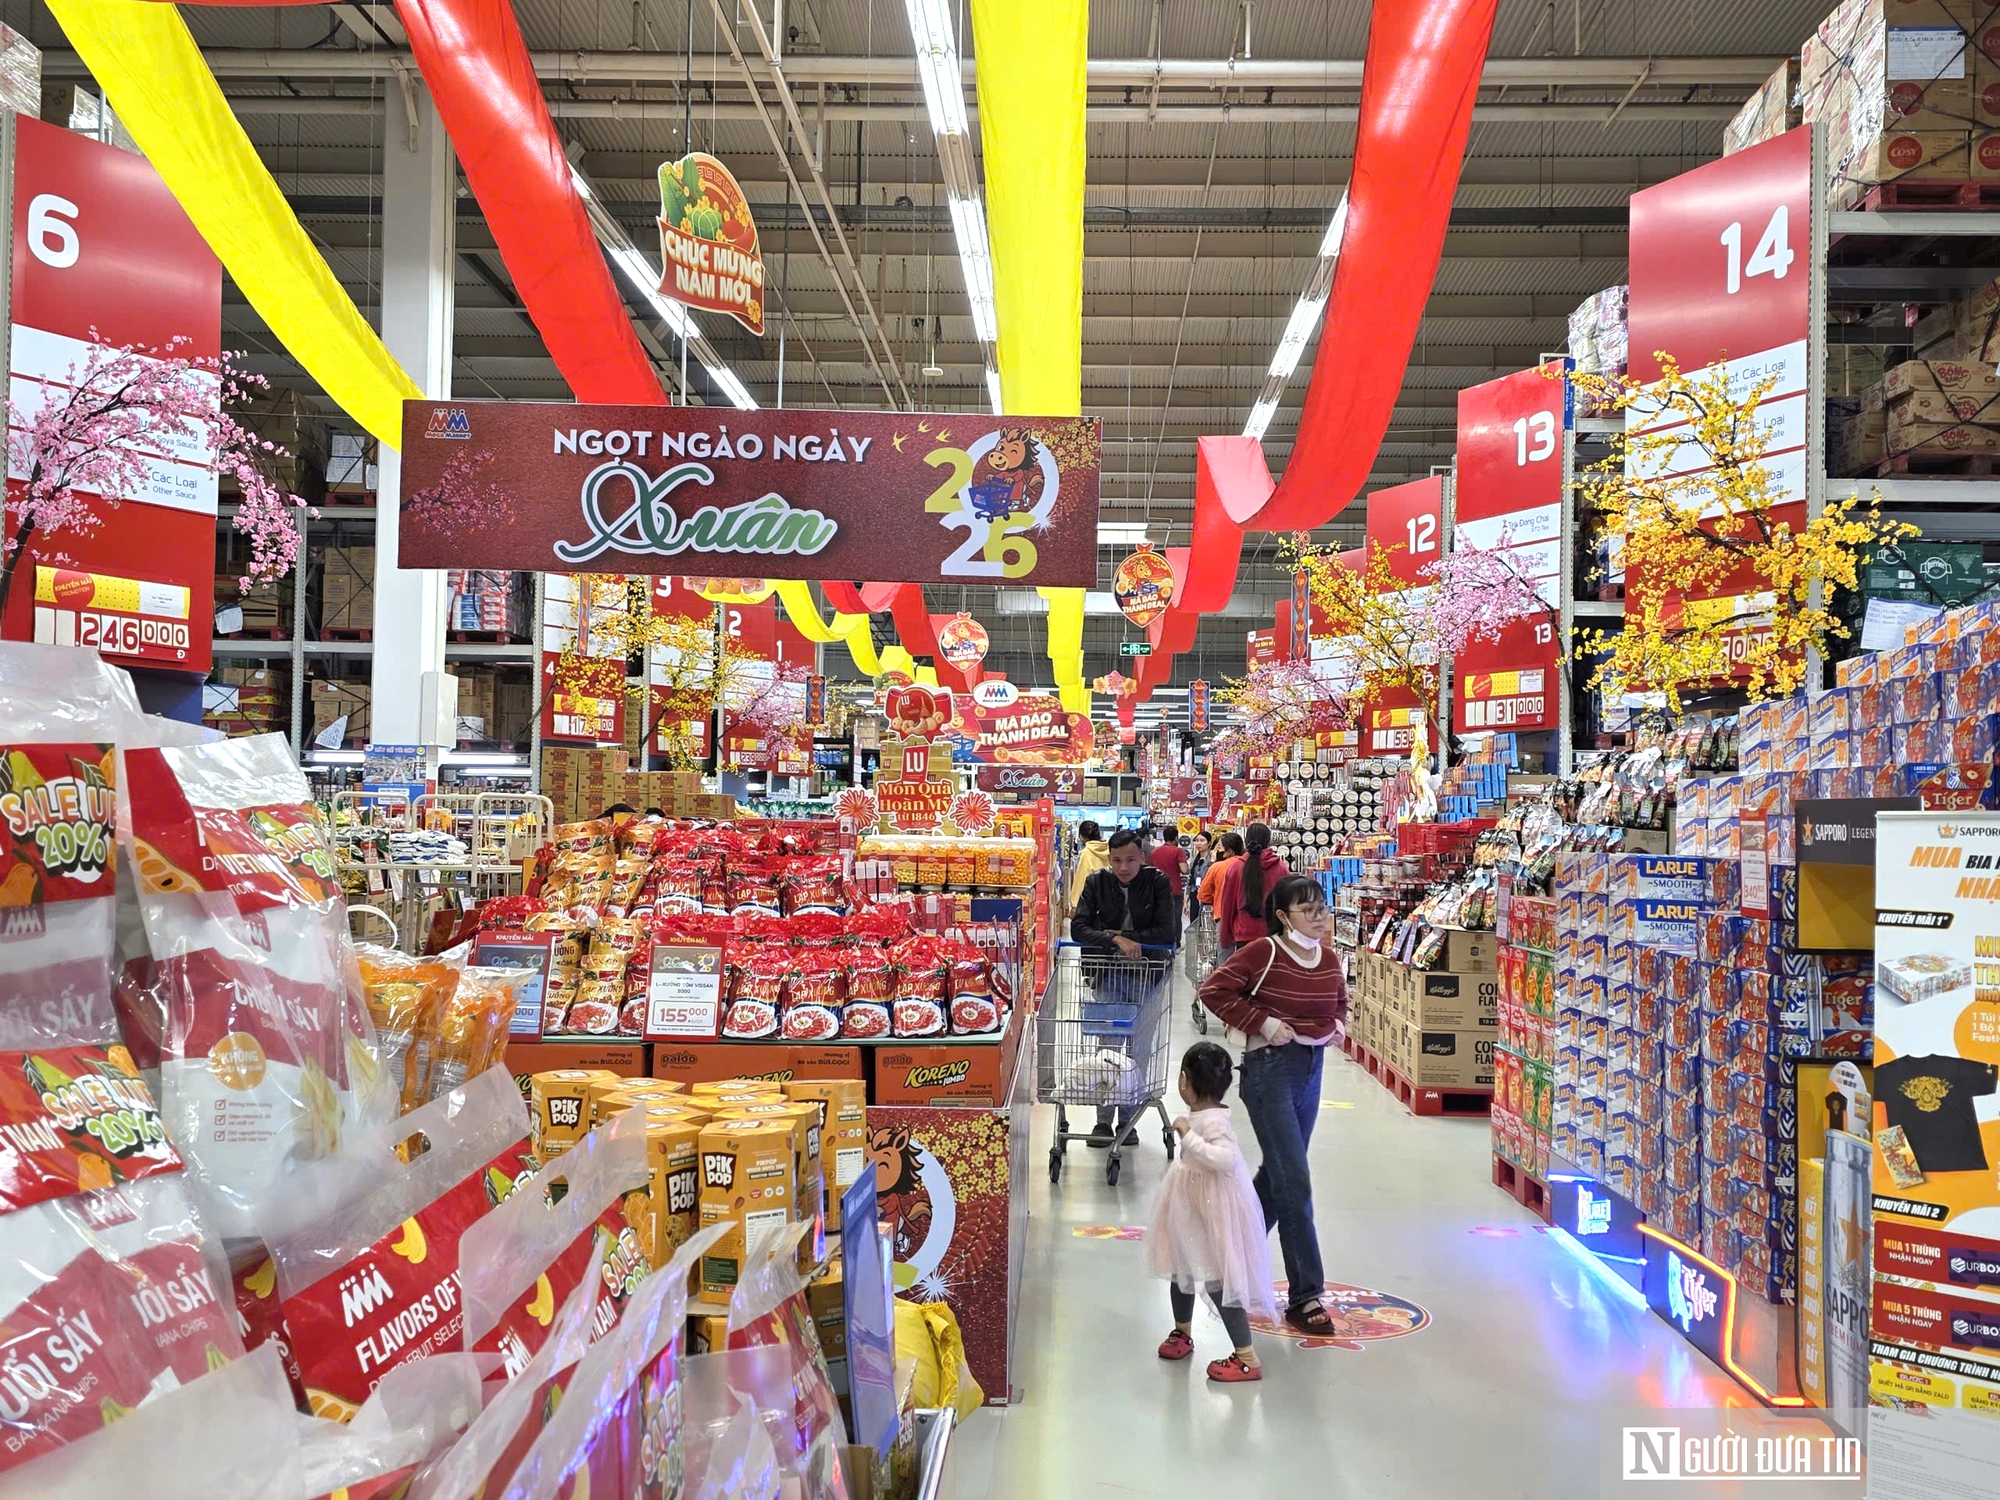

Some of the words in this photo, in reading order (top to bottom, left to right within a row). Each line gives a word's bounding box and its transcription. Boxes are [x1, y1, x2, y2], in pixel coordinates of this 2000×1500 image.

[1890, 145, 1919, 157] COSY
[26, 193, 81, 269] 6
[664, 229, 710, 271] CHÚC
[713, 243, 763, 287] MỪNG
[1720, 204, 1795, 295] 14
[675, 264, 716, 300] NĂM
[719, 275, 751, 305] MỚI
[1742, 366, 1761, 381] Các
[178, 438, 198, 450] Sauce
[553, 429, 653, 465] NGỌT
[661, 425, 763, 460] NGÀO
[773, 428, 872, 463] NGÀY
[1512, 409, 1556, 467] 13
[151, 469, 173, 485] Các
[152, 485, 173, 496] Other
[175, 488, 197, 500] Sauce
[553, 461, 838, 564] Xuân
[1406, 512, 1436, 556] 12
[61, 586, 91, 598] PROMOTION
[728, 610, 742, 637] 2
[1534, 623, 1552, 644] 13
[776, 640, 784, 662] 1
[545, 660, 555, 675] 4
[901, 695, 911, 705] LU
[725, 715, 732, 726] 2
[994, 714, 1019, 732] MÃ
[1020, 711, 1053, 729] ĐÁO
[978, 728, 1031, 747] THÀNH
[1031, 724, 1070, 741] DEAL
[905, 751, 924, 773] LU
[879, 782, 915, 797] Món
[918, 782, 952, 797] Quà
[1, 785, 79, 834] SALE
[879, 797, 923, 812] Hoàn
[927, 796, 952, 815] Mỹ
[1931, 792, 1973, 811] Tiger
[911, 811, 936, 821] 1846
[1815, 823, 1847, 842] SAPPORO
[36, 821, 106, 867] 20%
[1909, 845, 1963, 869] MUA
[1965, 854, 1994, 870] BIA
[1645, 860, 1698, 876] LARUE
[1652, 879, 1693, 890] SMOOTH
[1645, 904, 1699, 920] LARUE
[1877, 911, 1914, 925] KHUYẾN
[1915, 912, 1936, 926] MÃI
[495, 931, 521, 941] KHUYẾN
[521, 932, 535, 942] MÃI
[1649, 922, 1690, 932] SMOOTH
[1429, 985, 1456, 996] Kellogg's
[1425, 1043, 1453, 1054] Kellogg's
[660, 1051, 698, 1068] paldo
[903, 1059, 971, 1090] KORENO
[942, 1074, 967, 1087] JUMBO
[41, 1081, 119, 1131] SALE
[552, 1113, 579, 1125] POP
[86, 1109, 166, 1153] 20%
[706, 1172, 732, 1186] POP
[671, 1192, 695, 1213] POP
[1873, 1197, 1911, 1214] KHUYẾN
[1911, 1201, 1931, 1217] MÃI
[1931, 1207, 1941, 1219] 2
[747, 1213, 771, 1221] NUTRITION
[1883, 1238, 1904, 1252] MUA
[1905, 1242, 1910, 1252] 1
[1911, 1240, 1942, 1258] THÙNG
[1889, 1251, 1912, 1263] NHẬN
[1912, 1255, 1934, 1266] NGAY
[168, 1262, 217, 1317] SẤY
[1882, 1300, 1903, 1314] MUA
[1903, 1304, 1911, 1316] 5
[1912, 1303, 1943, 1321] THÙNG
[180, 1317, 208, 1340] CHIPS
[355, 1294, 441, 1374] FLAVORS
[433, 1279, 460, 1313] OF
[1888, 1313, 1911, 1325] NHẬN
[1911, 1317, 1933, 1329] NGAY
[48, 1302, 104, 1374] SẤY
[1872, 1343, 1899, 1358] THAM
[1899, 1348, 1916, 1361] GIA
[1917, 1351, 1958, 1371] CHƯƠNG
[1959, 1358, 1989, 1378] TRÌNH
[1877, 1377, 1894, 1387] QUÉT
[1894, 1381, 1905, 1390] MÃ
[1915, 1385, 1933, 1396] BẰNG
[1933, 1392, 1950, 1400] ZALO
